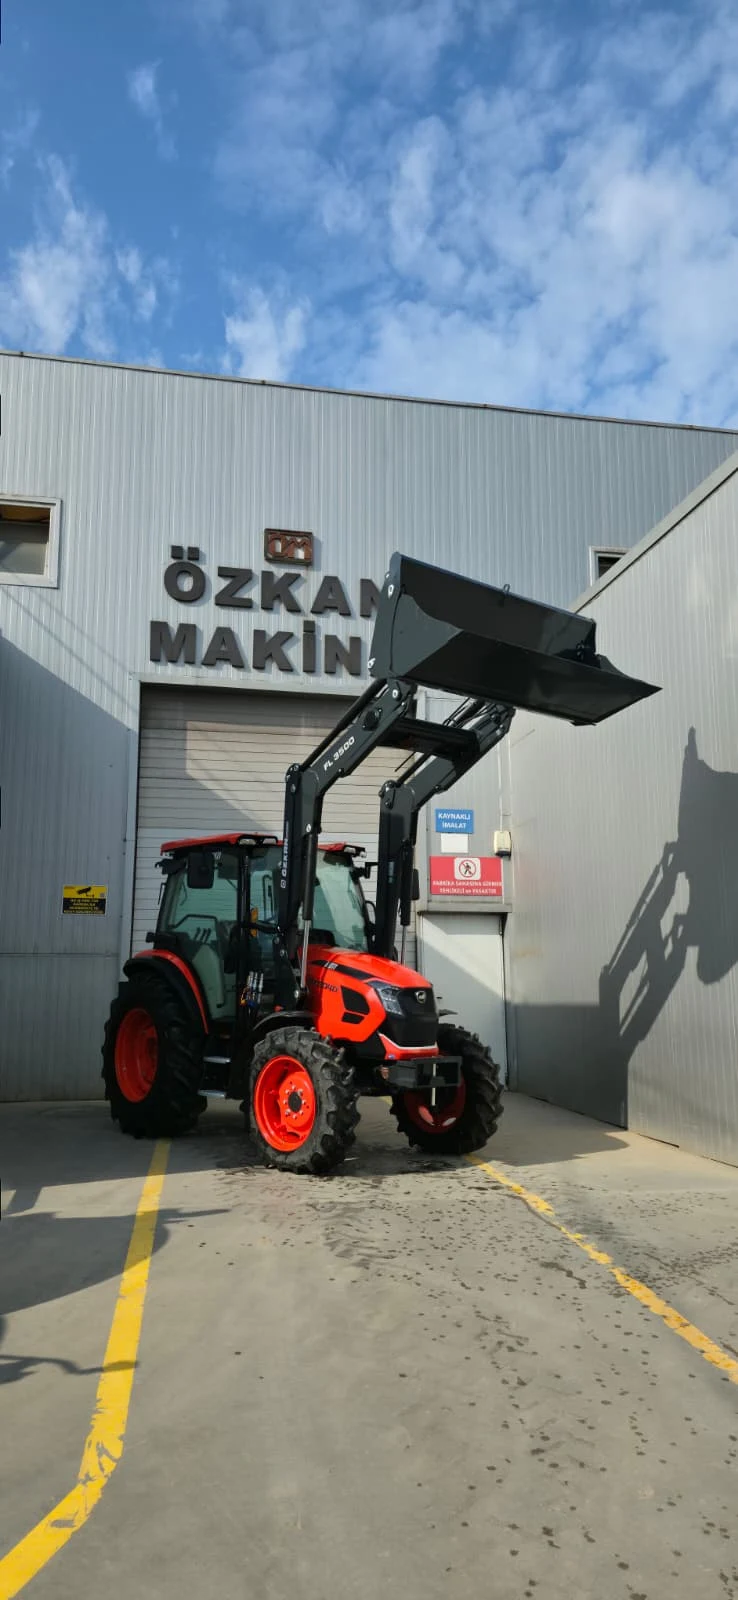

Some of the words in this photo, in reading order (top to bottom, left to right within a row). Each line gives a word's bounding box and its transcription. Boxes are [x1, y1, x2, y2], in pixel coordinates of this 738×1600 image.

[163, 545, 383, 617] ÖZKAN
[150, 620, 362, 676] MAKİN
[323, 760, 334, 771] FL
[333, 735, 355, 761] 3500
[438, 812, 471, 820] KAYNAKLI
[442, 820, 467, 829] İMALAT
